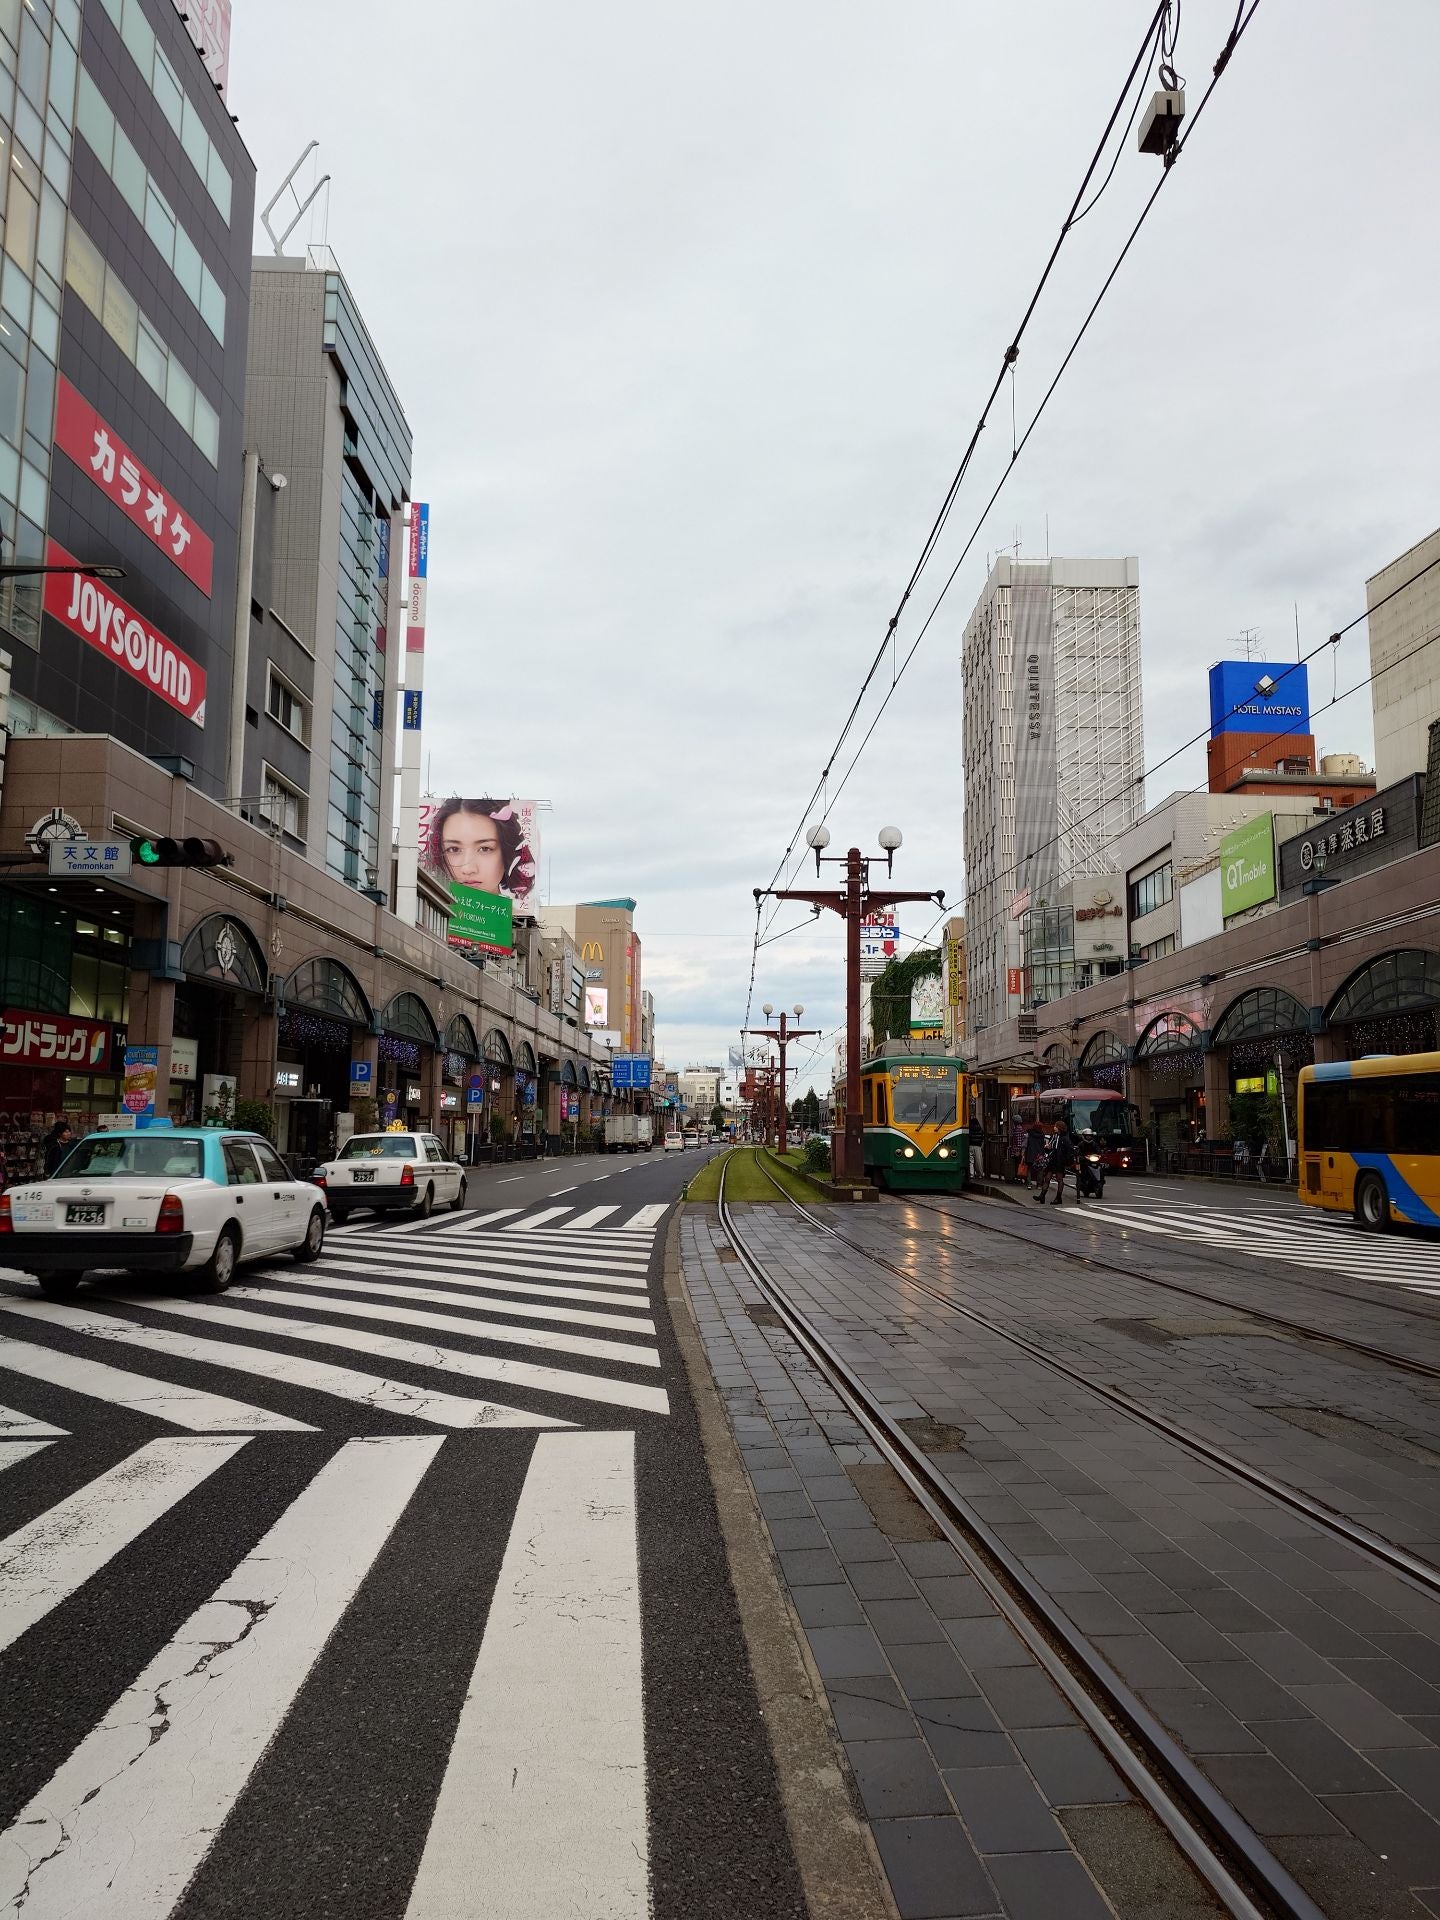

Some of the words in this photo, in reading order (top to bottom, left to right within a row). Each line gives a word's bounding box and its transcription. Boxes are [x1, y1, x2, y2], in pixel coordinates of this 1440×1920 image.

[90, 428, 191, 556] カラオケ
[411, 583, 419, 621] docomo
[67, 572, 192, 706] JOYSOUND
[1027, 654, 1041, 740] QUINTESSA
[1233, 704, 1261, 714] HOTEL
[1263, 706, 1302, 716] MYSTAYS
[63, 846, 120, 861] 天文館
[67, 861, 114, 870] Tenmonkan
[356, 1063, 368, 1080] P
[471, 1089, 480, 1101] P
[571, 1106, 577, 1114] P
